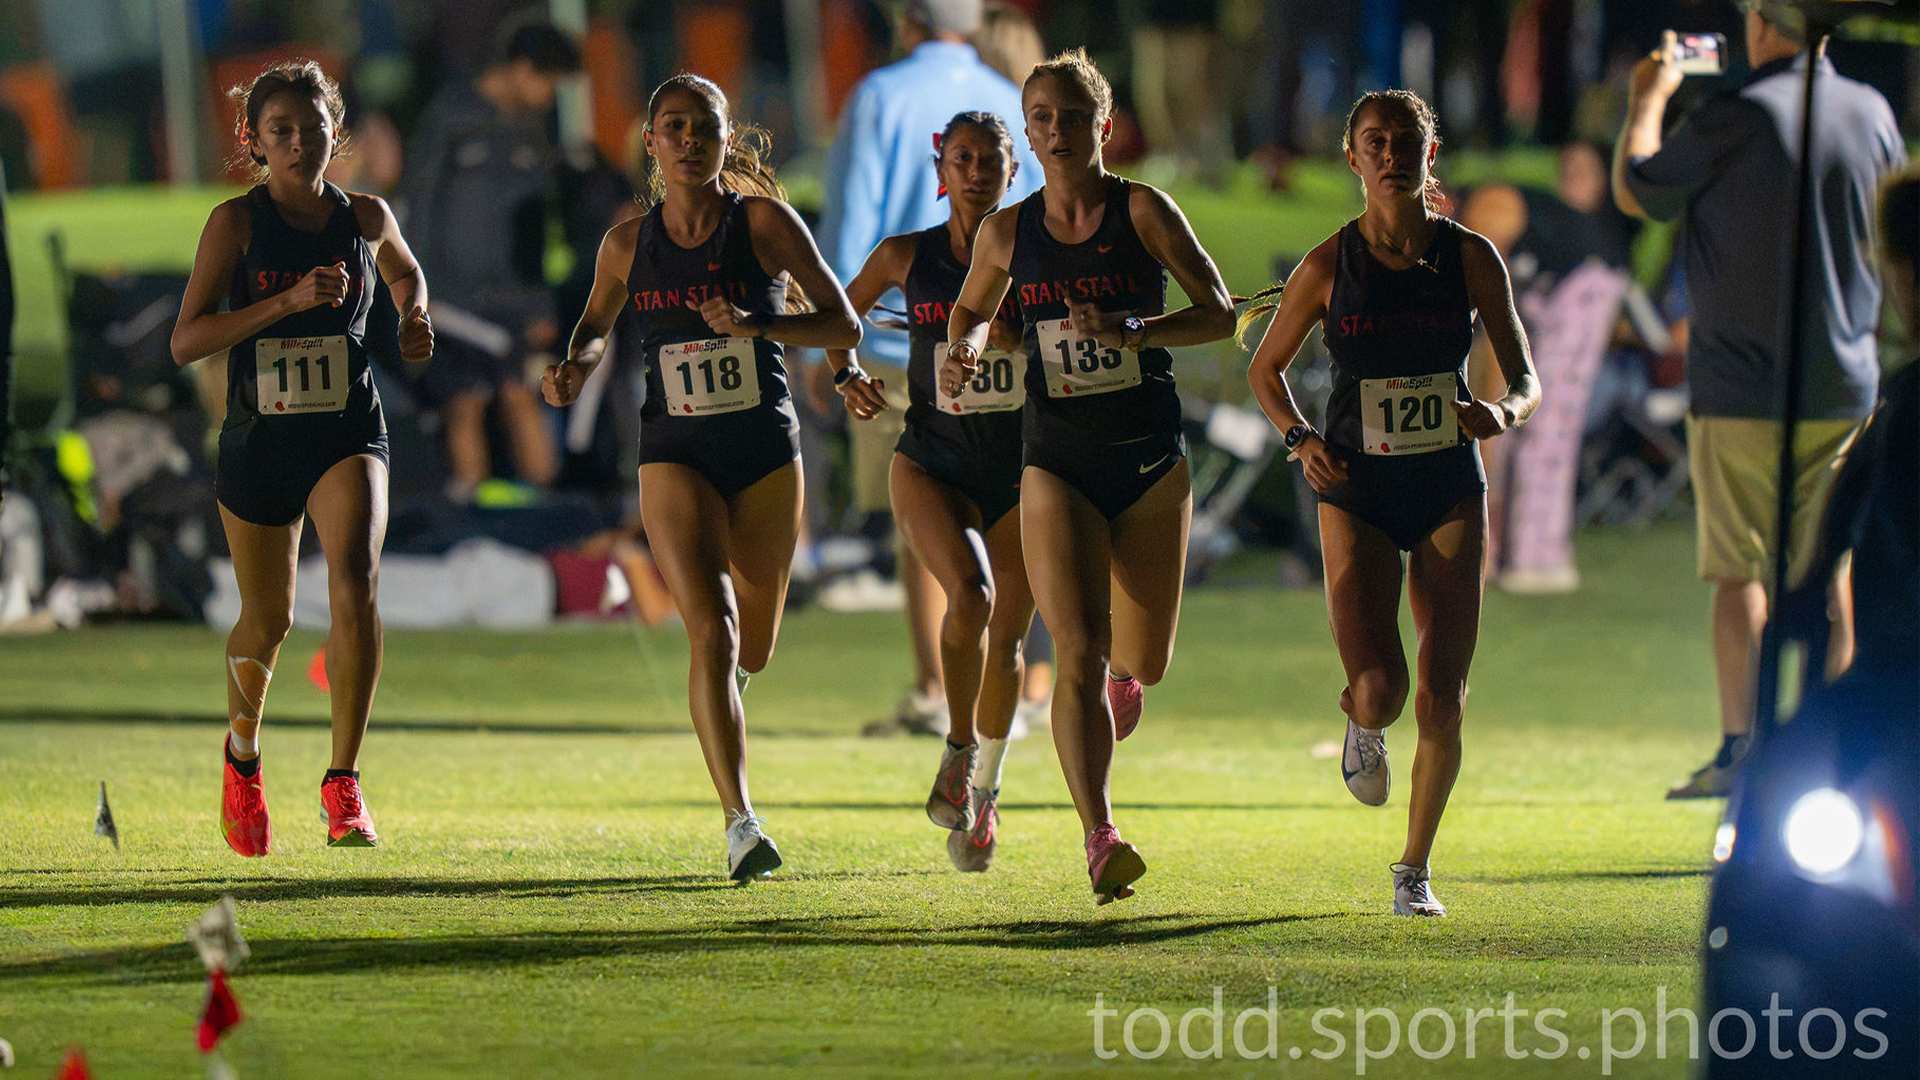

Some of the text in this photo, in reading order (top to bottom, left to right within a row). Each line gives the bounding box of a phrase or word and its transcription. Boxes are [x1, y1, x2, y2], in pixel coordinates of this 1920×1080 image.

[257, 270, 302, 291] STA
[634, 289, 680, 311] STAN
[1020, 281, 1070, 306] STAN
[683, 339, 728, 355] MileSplit
[272, 355, 330, 393] 111
[676, 355, 742, 396] 118
[971, 358, 1014, 394] 30
[1386, 376, 1433, 391] MileSplit
[1378, 394, 1443, 434] 120
